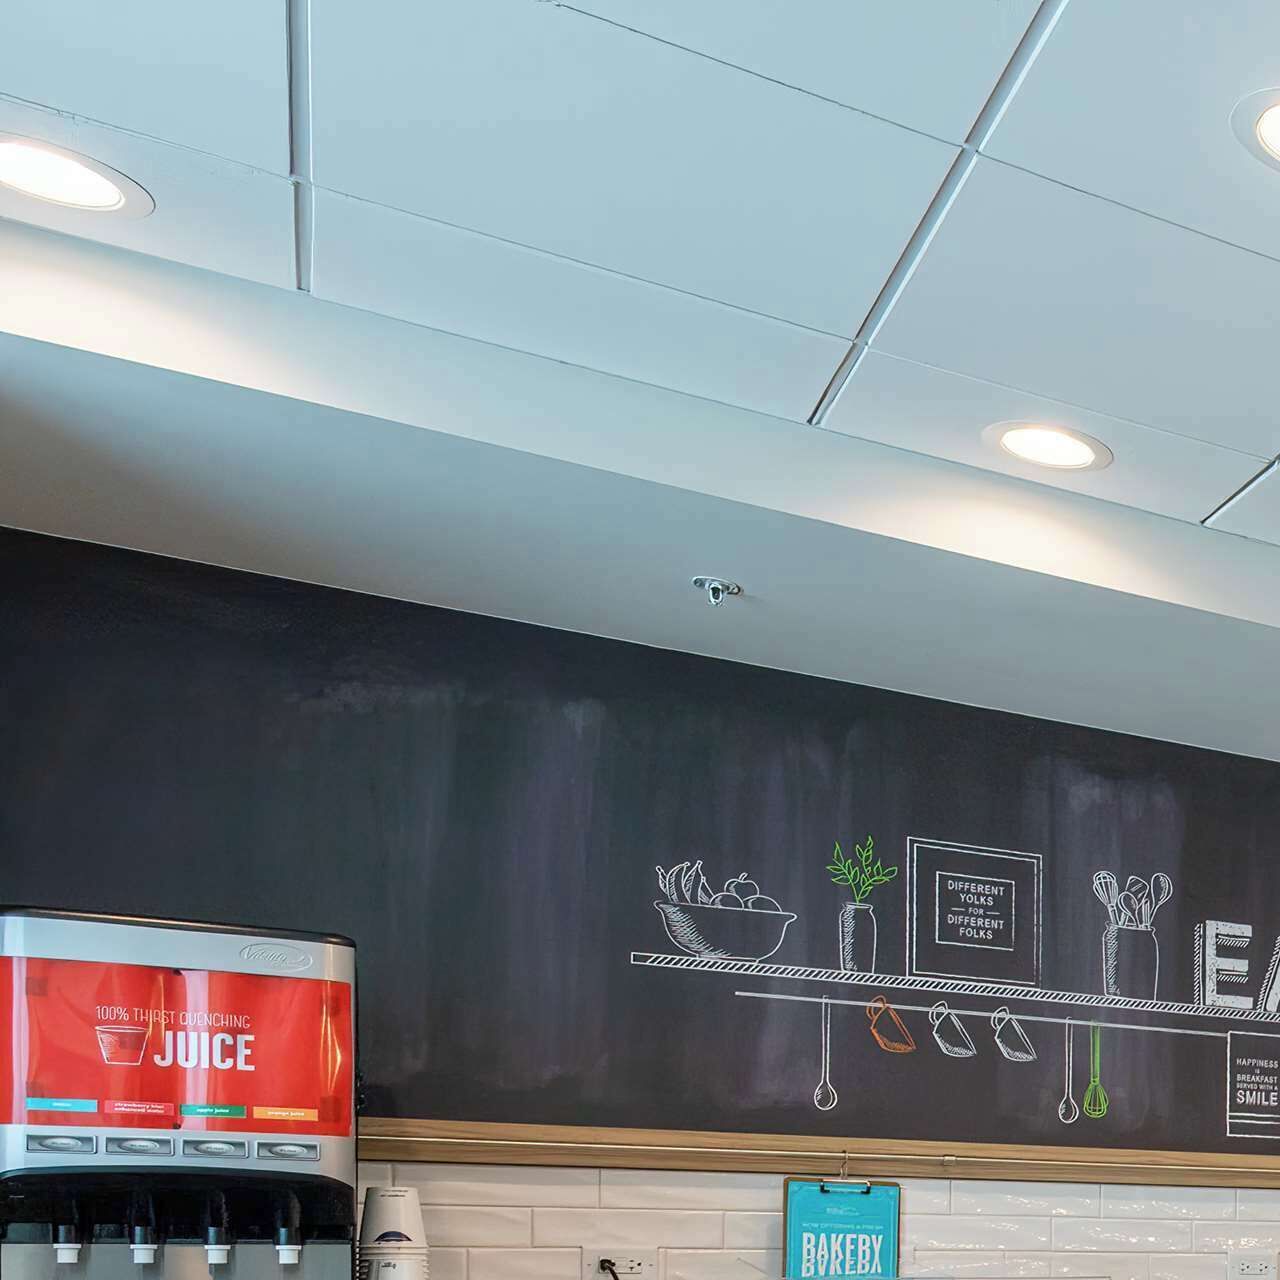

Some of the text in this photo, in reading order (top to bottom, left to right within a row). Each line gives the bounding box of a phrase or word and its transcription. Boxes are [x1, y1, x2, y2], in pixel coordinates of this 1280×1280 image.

[947, 880, 1005, 896] DIFFERENT
[960, 893, 993, 906] YOLKS
[968, 907, 984, 916] FOR
[947, 914, 1004, 929] DIFFERENT
[960, 927, 993, 940] FOLKS
[96, 1005, 250, 1028] 100% THIRST QUENCHING
[154, 1030, 255, 1071] JUICE
[1236, 1057, 1279, 1069] HAPPINESS
[1236, 1074, 1278, 1084] BREAKFAST
[1236, 1090, 1279, 1107] SMILE
